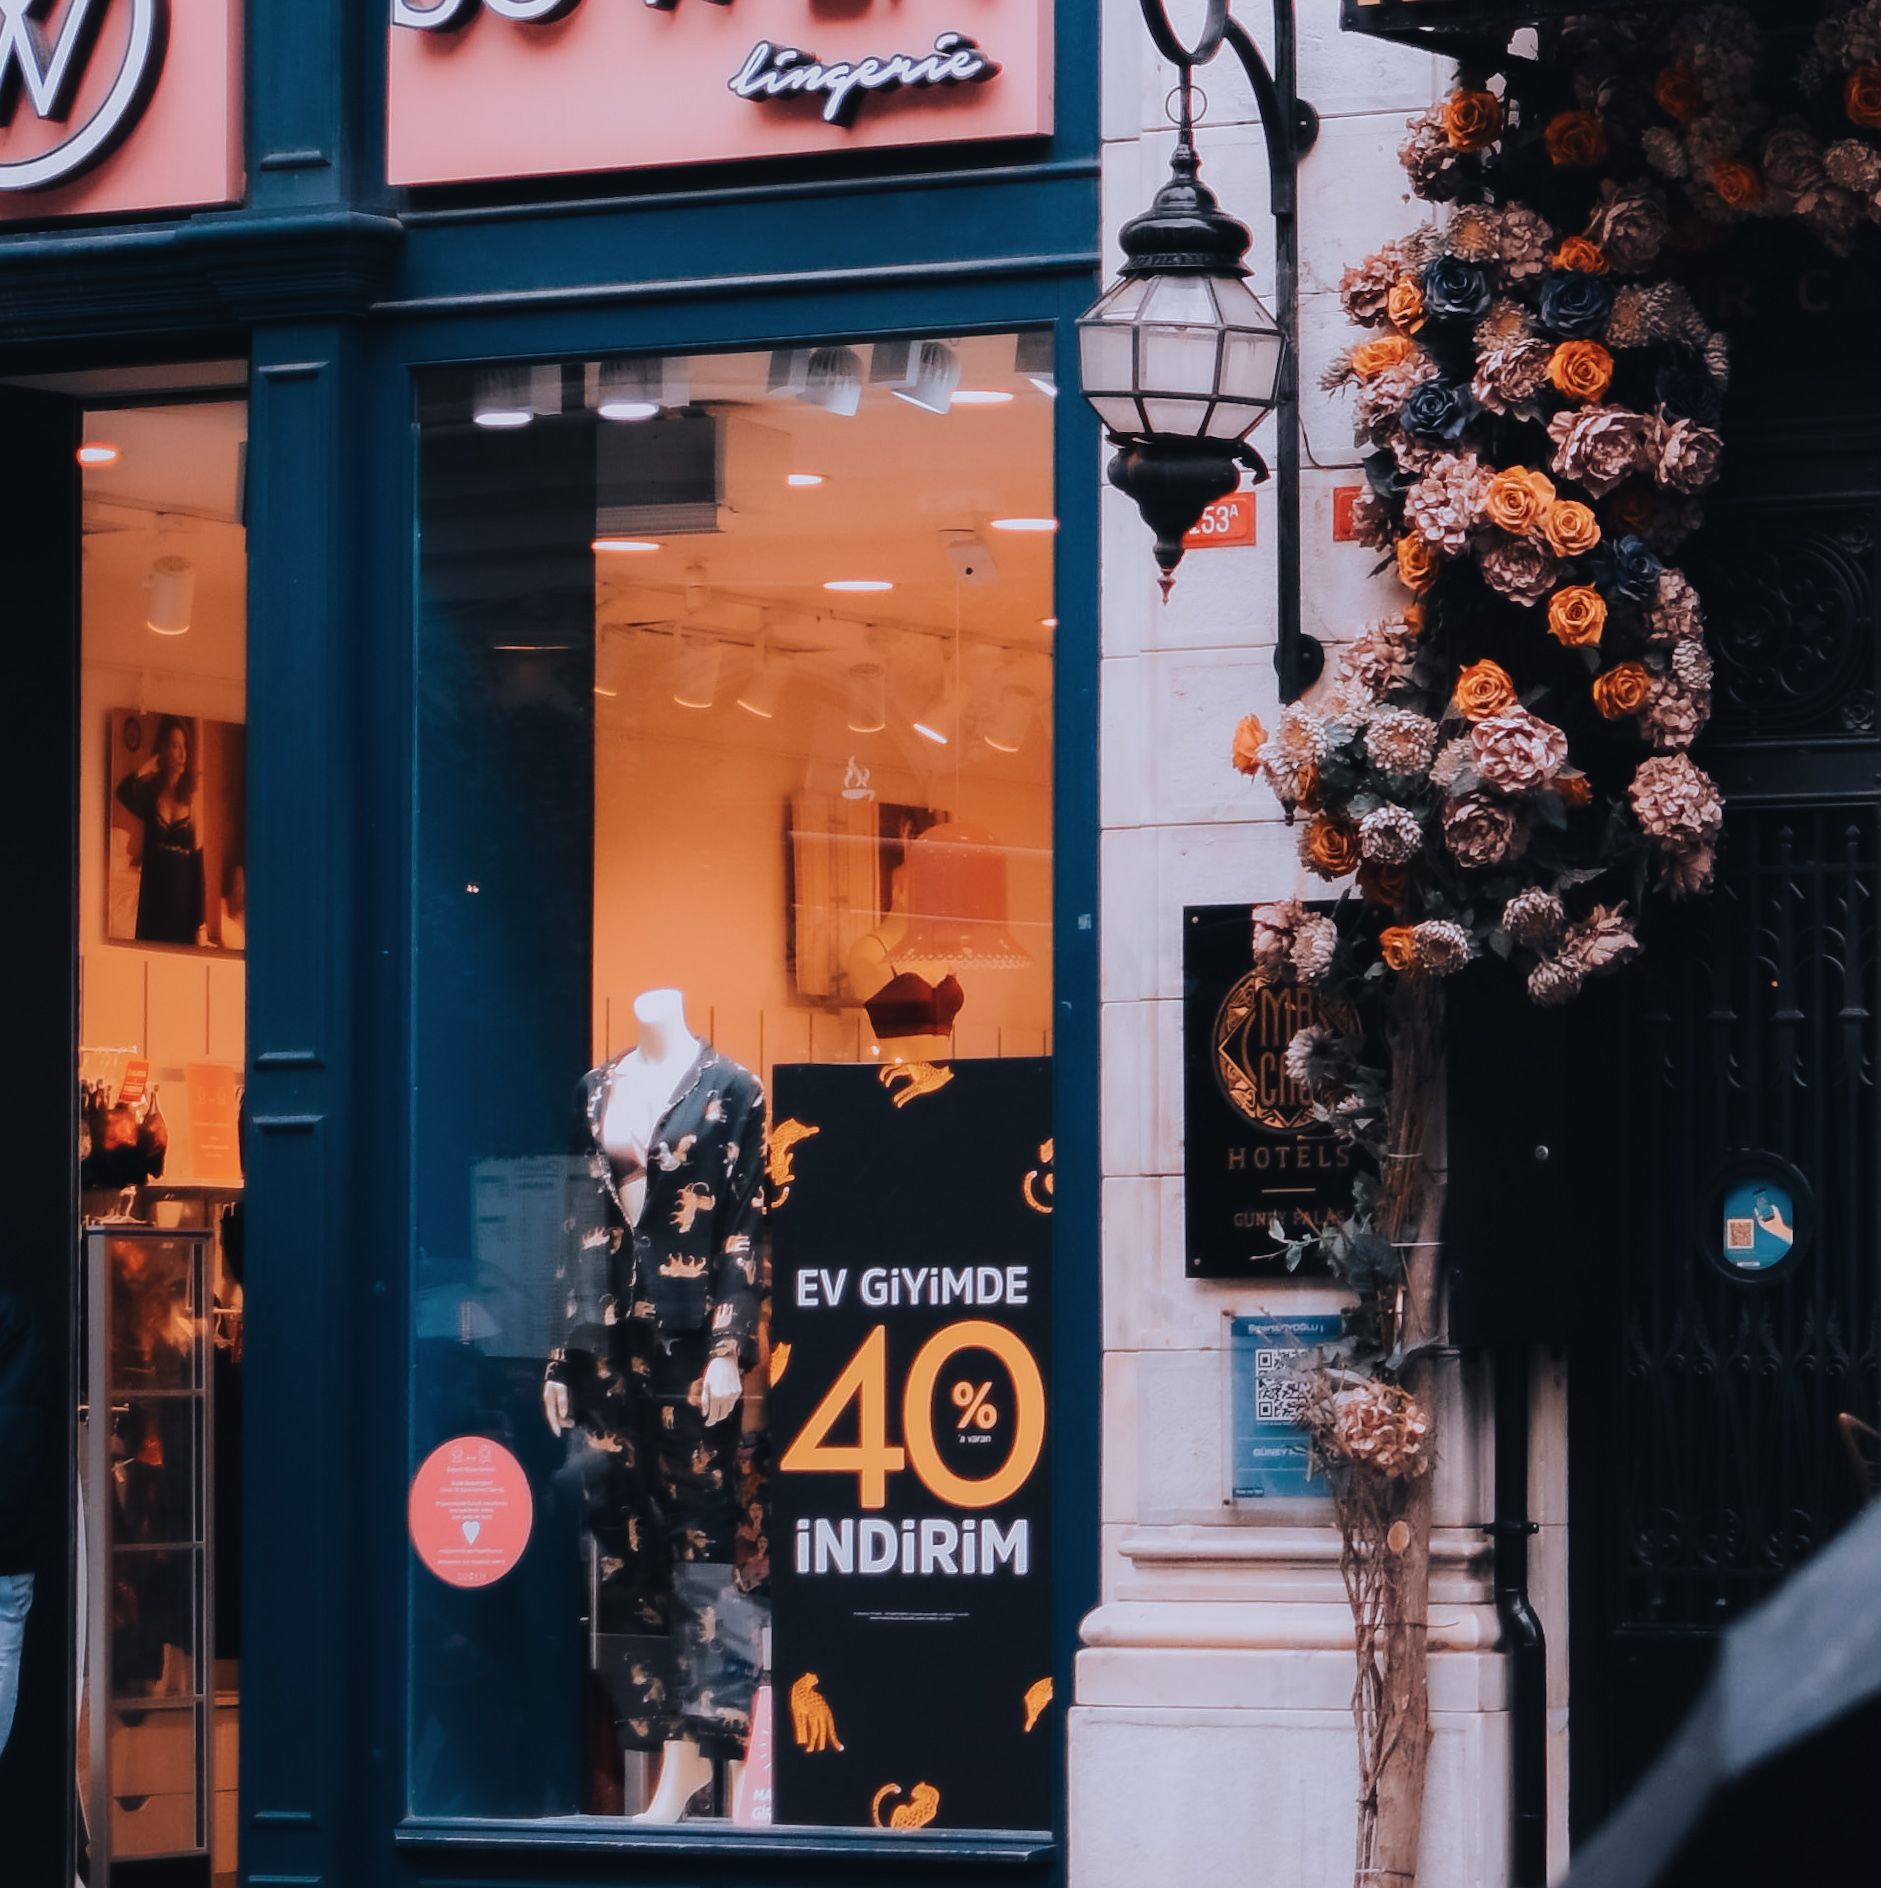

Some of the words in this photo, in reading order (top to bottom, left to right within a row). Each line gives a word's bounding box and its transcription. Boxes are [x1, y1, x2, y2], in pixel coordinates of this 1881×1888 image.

[728, 32, 1001, 126] lingerie
[1228, 1144, 1350, 1170] HOTELS
[795, 1268, 848, 1308] EV
[779, 1319, 1046, 1510] 40
